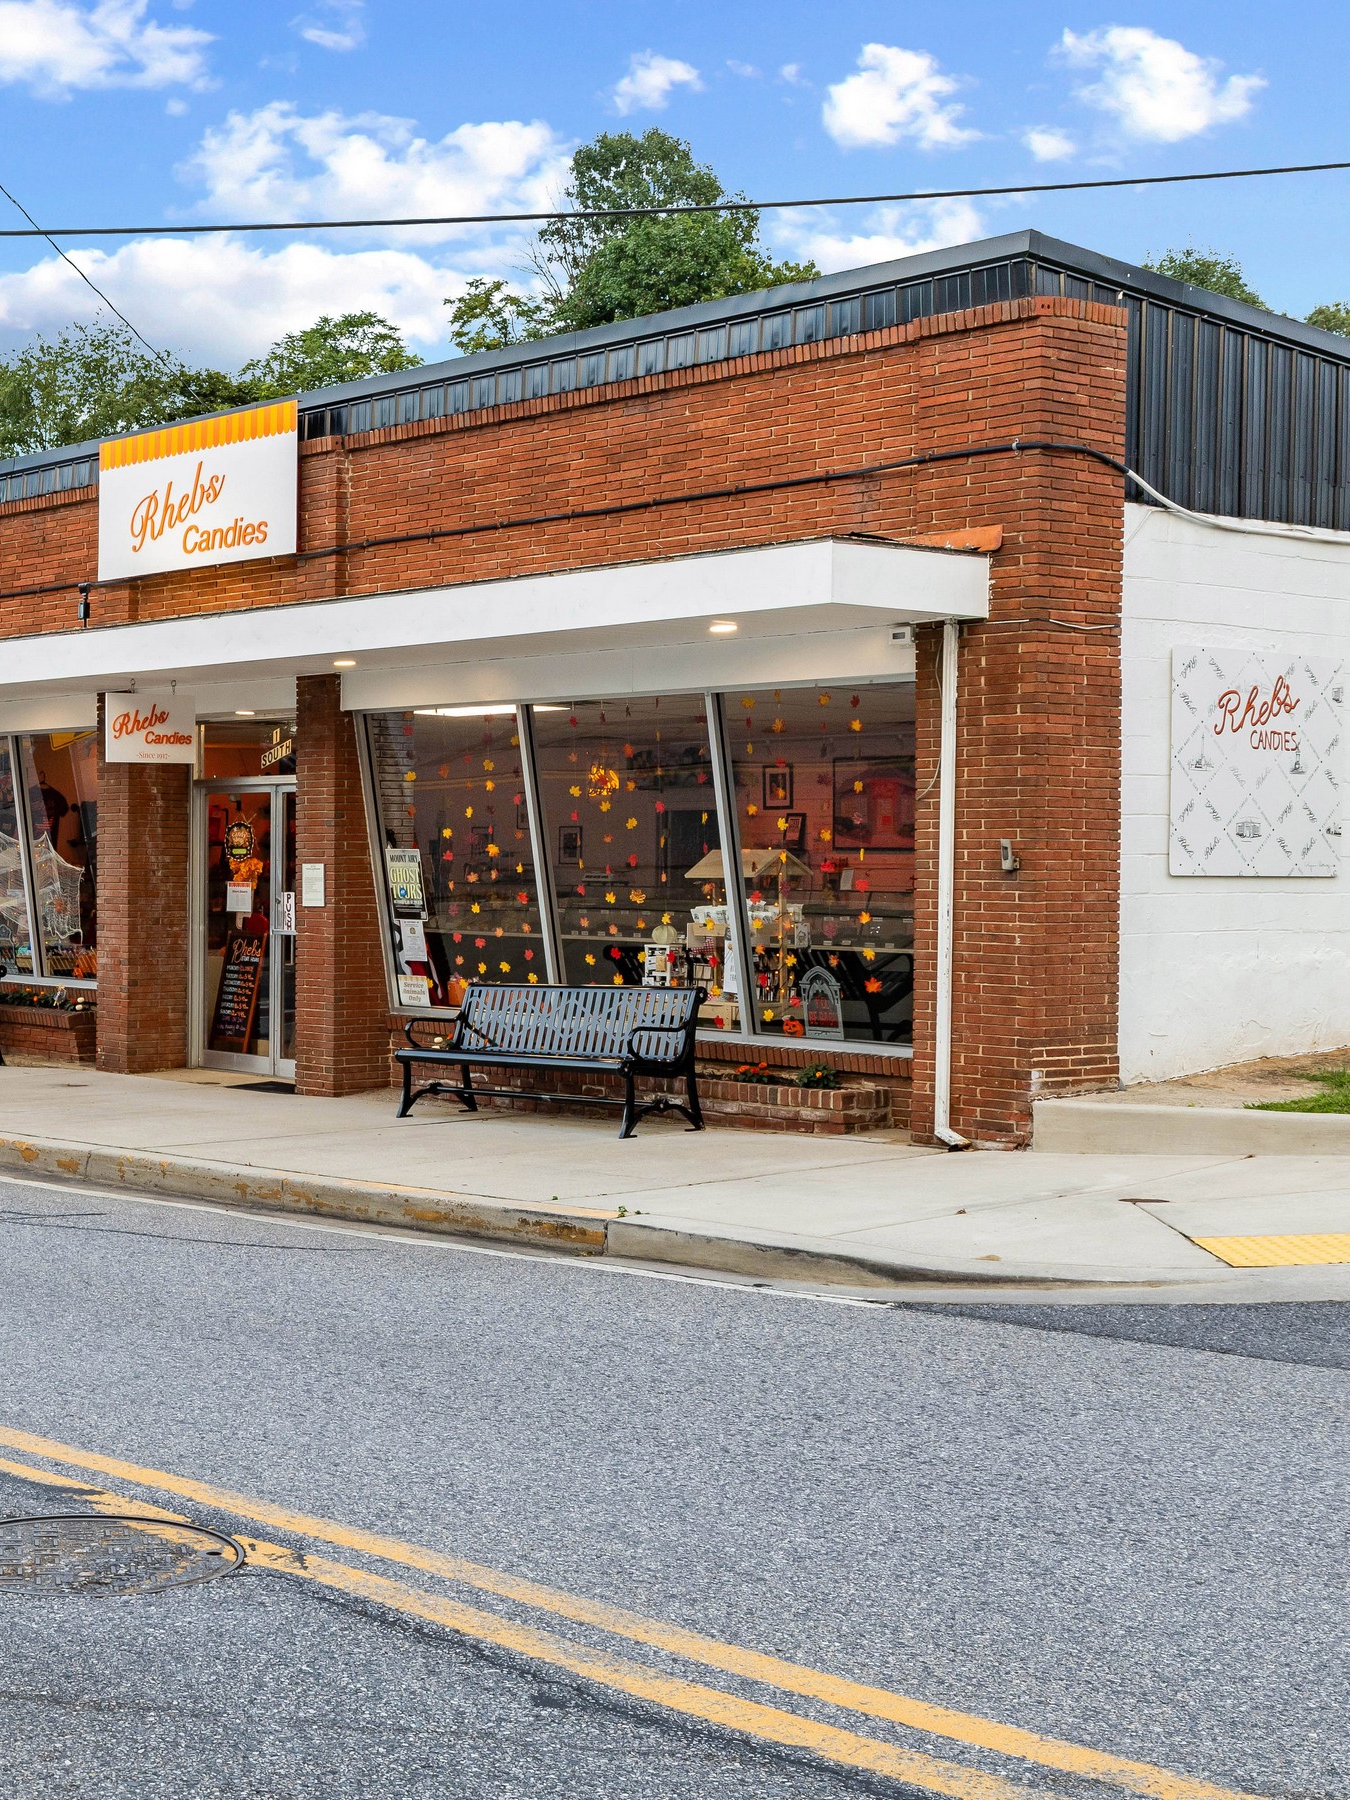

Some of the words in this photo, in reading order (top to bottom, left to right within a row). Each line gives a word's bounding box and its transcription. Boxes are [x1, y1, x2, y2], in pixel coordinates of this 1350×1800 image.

[182, 516, 269, 555] Candies
[144, 730, 193, 745] Candies
[1250, 729, 1298, 752] CANDIES
[262, 740, 291, 767] SOUTH
[389, 854, 407, 863] MOUNT
[390, 867, 420, 883] GHOST
[392, 883, 423, 900] TOURS
[402, 988, 426, 996] Animals
[403, 981, 425, 989] Service
[408, 995, 422, 1003] Only
